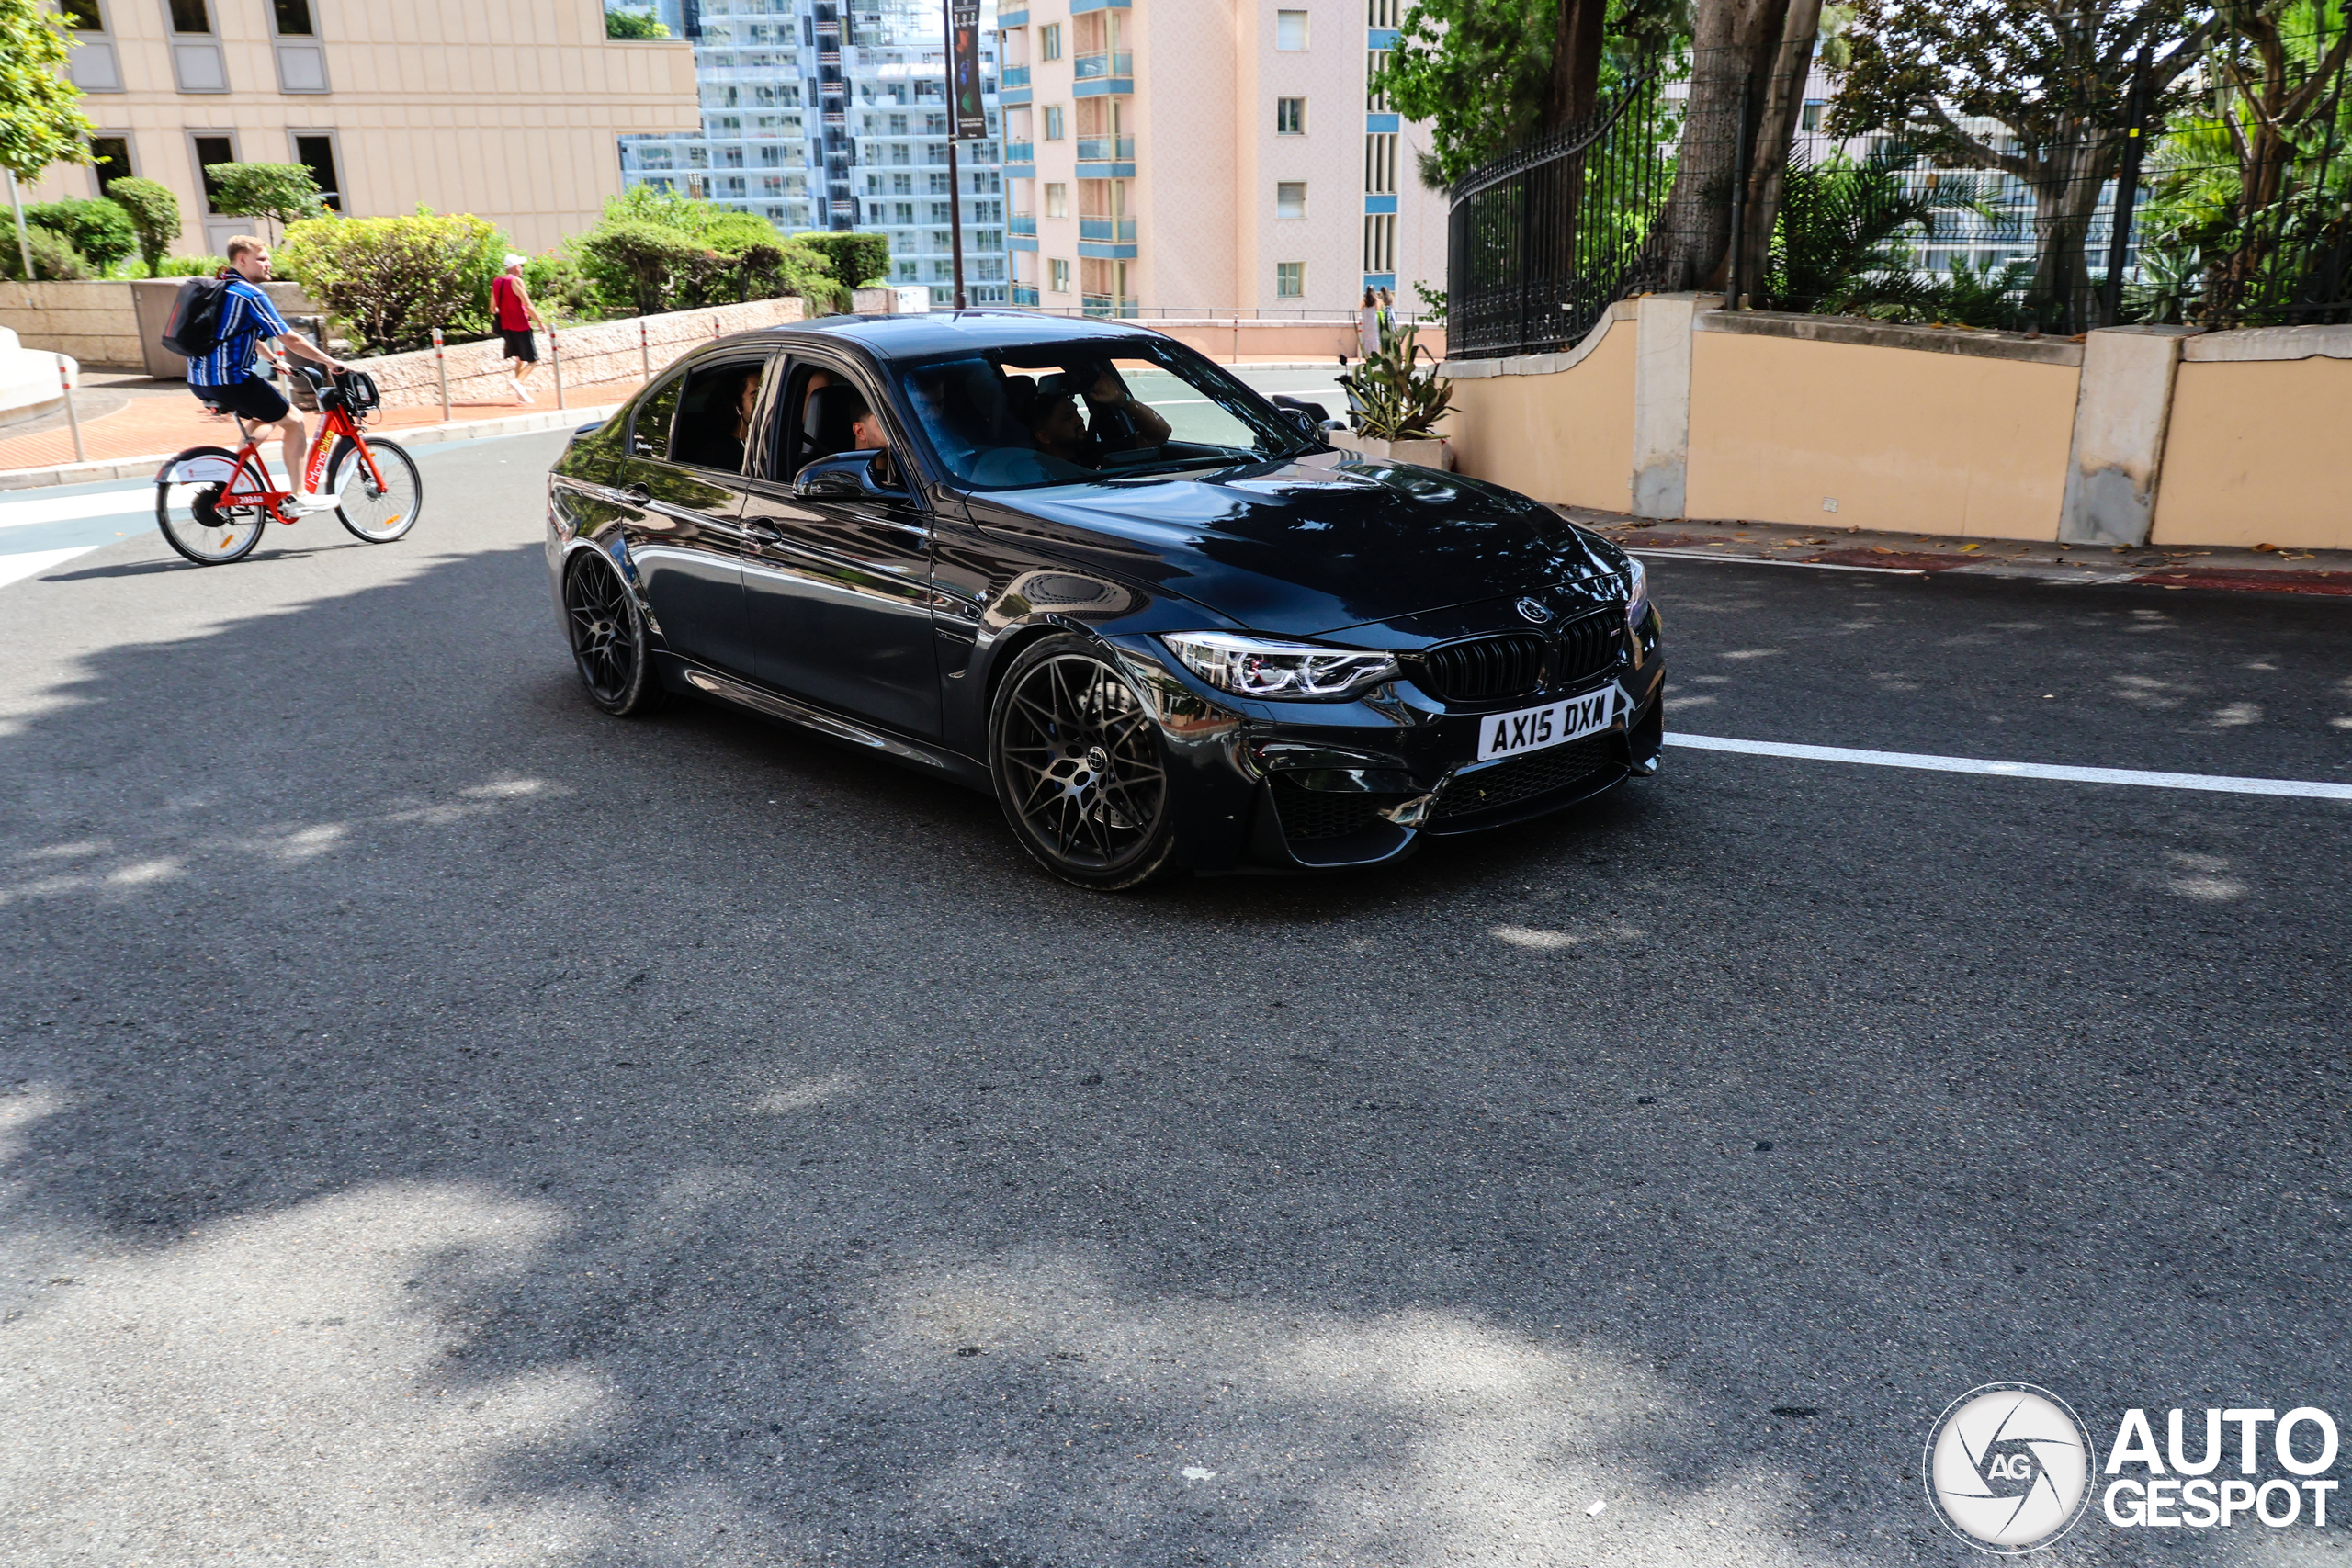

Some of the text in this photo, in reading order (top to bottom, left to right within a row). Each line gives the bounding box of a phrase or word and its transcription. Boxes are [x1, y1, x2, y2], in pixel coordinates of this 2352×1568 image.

[307, 430, 334, 484] MonaBike
[1491, 694, 1606, 753] AX15 DXM
